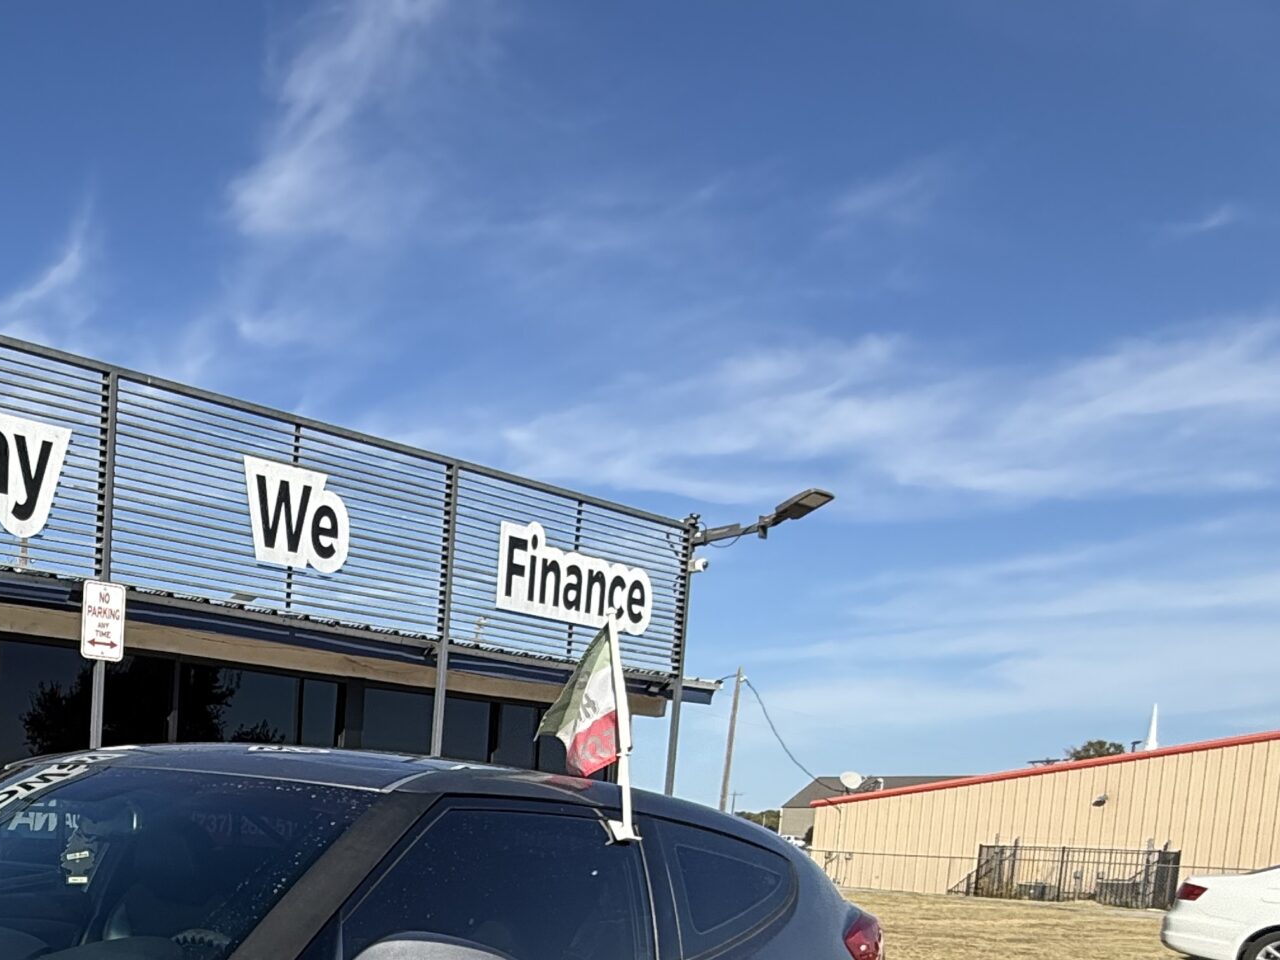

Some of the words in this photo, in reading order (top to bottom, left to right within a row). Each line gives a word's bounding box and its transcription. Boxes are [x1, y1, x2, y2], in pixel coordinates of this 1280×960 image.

[256, 474, 339, 559] We
[504, 534, 646, 624] Finance
[99, 591, 110, 604] NO
[87, 605, 120, 621] PARKING
[97, 621, 109, 629] ANY
[95, 629, 111, 639] TIME
